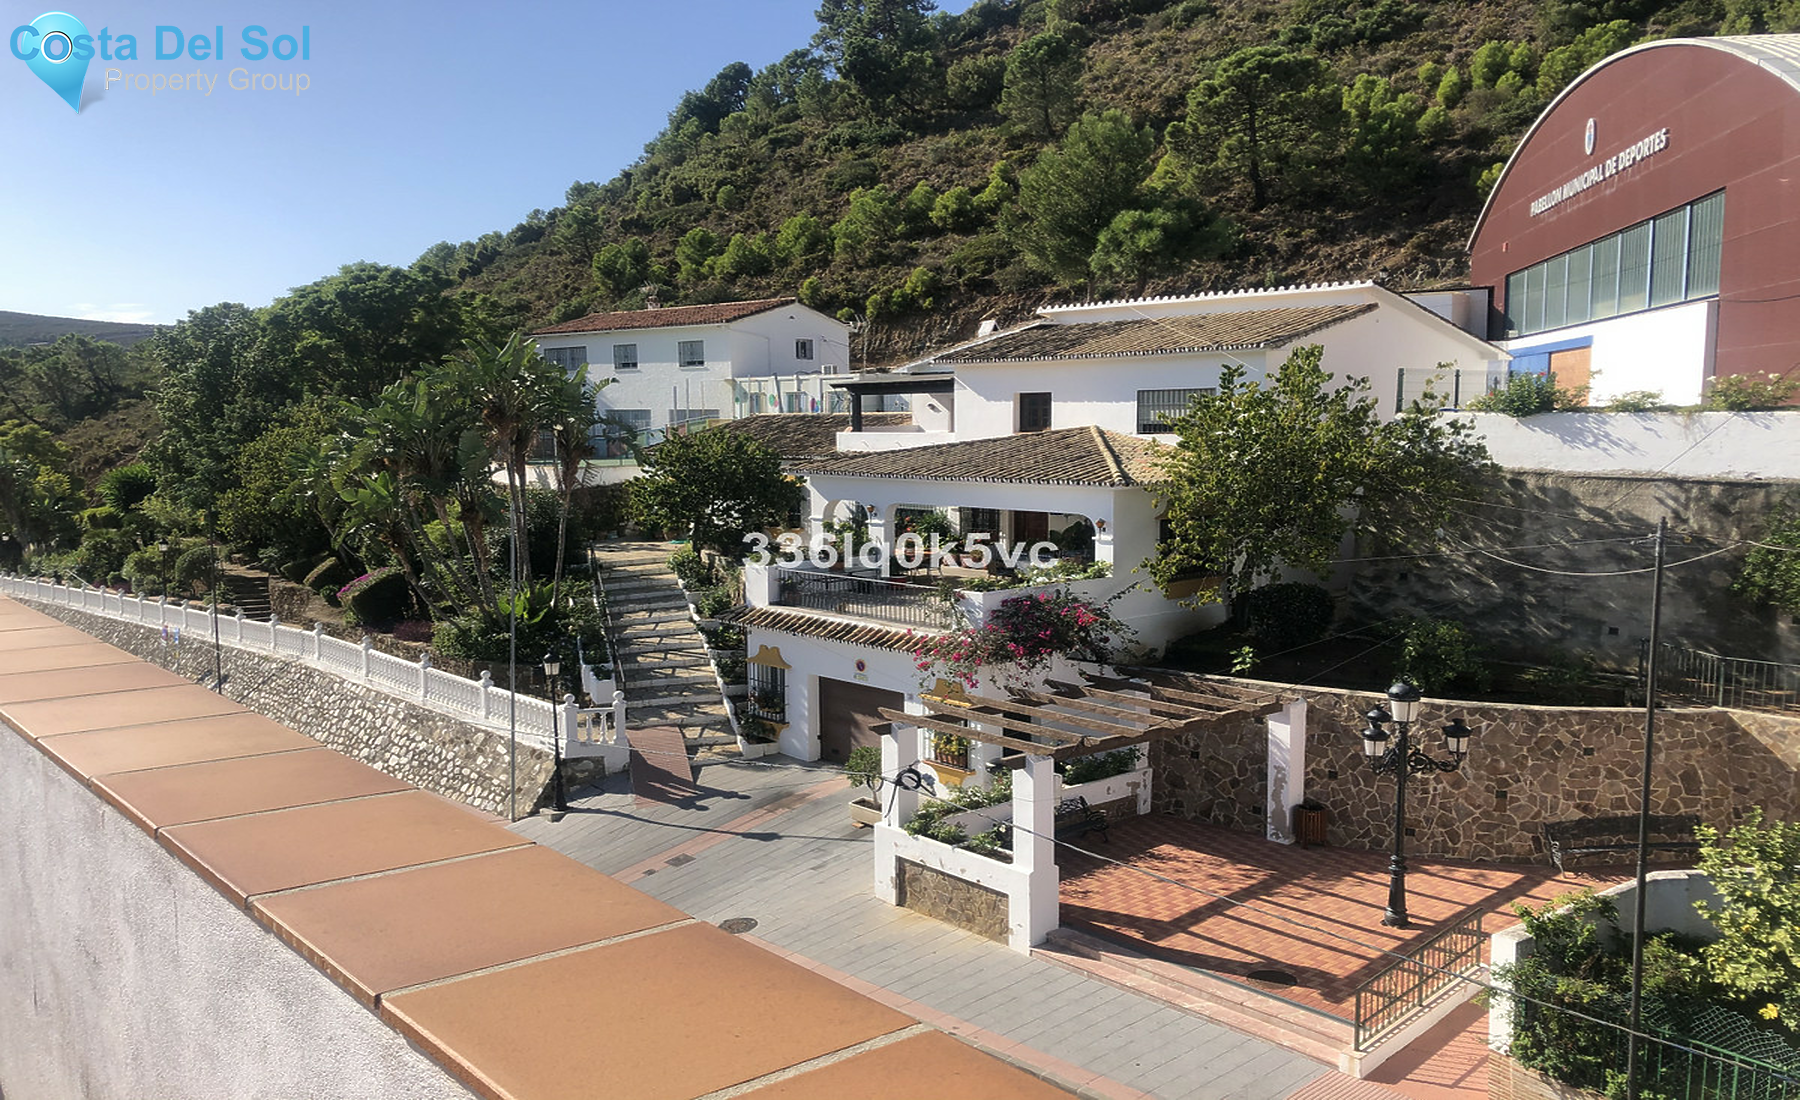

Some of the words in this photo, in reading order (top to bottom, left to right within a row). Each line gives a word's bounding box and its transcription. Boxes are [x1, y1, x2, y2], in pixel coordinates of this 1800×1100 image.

[1562, 164, 1604, 200] MUNICIPAL
[1605, 156, 1618, 177] DE
[1619, 128, 1668, 170] DEPORTES
